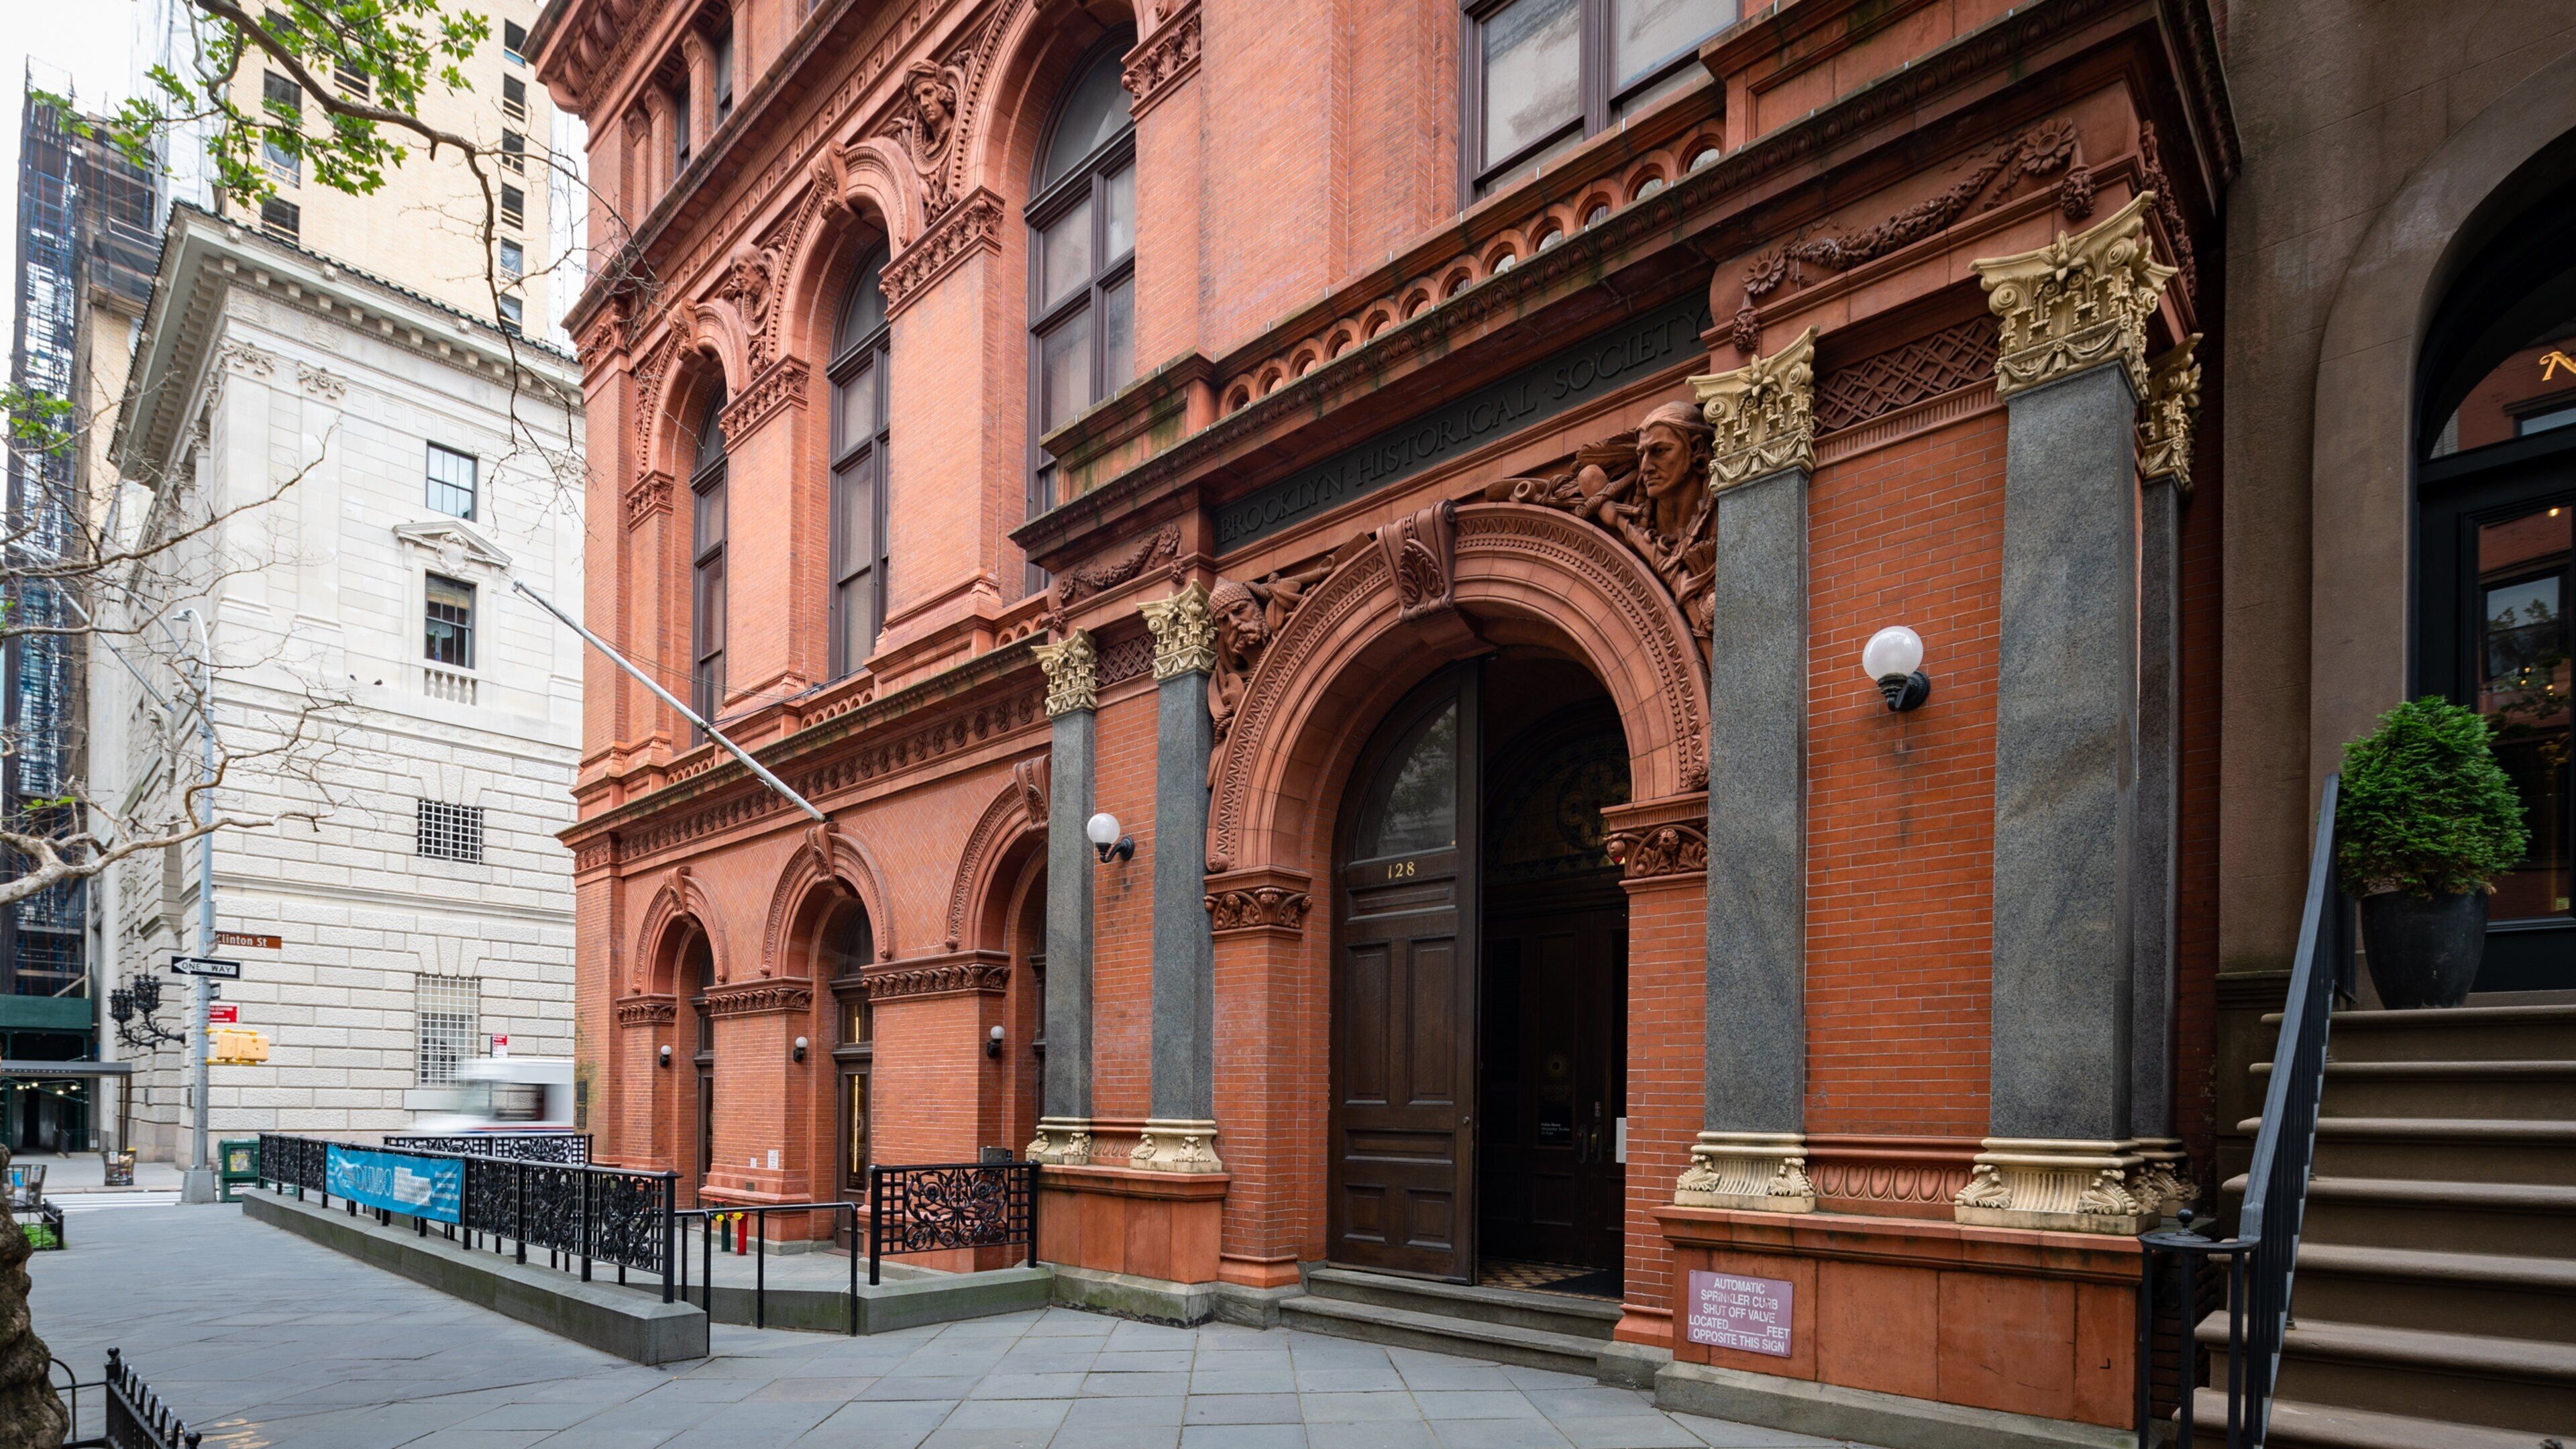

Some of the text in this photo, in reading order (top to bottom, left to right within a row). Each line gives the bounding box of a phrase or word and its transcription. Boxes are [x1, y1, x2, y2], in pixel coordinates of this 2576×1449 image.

[1221, 303, 1710, 544] BROOKLYN HISTORICAL SOCIETY
[1388, 861, 1415, 879] 128
[217, 934, 268, 947] Clinton St
[181, 962, 231, 973] ONE WAY
[1714, 1277, 1765, 1294] AUTOMATIC
[1701, 1289, 1750, 1306] SPRINKLER
[1703, 1303, 1776, 1324] SHUT OFF VALVE
[1689, 1314, 1790, 1339] LOCATED FEET
[1693, 1328, 1784, 1353] OPPOSITE THIS SIGN
